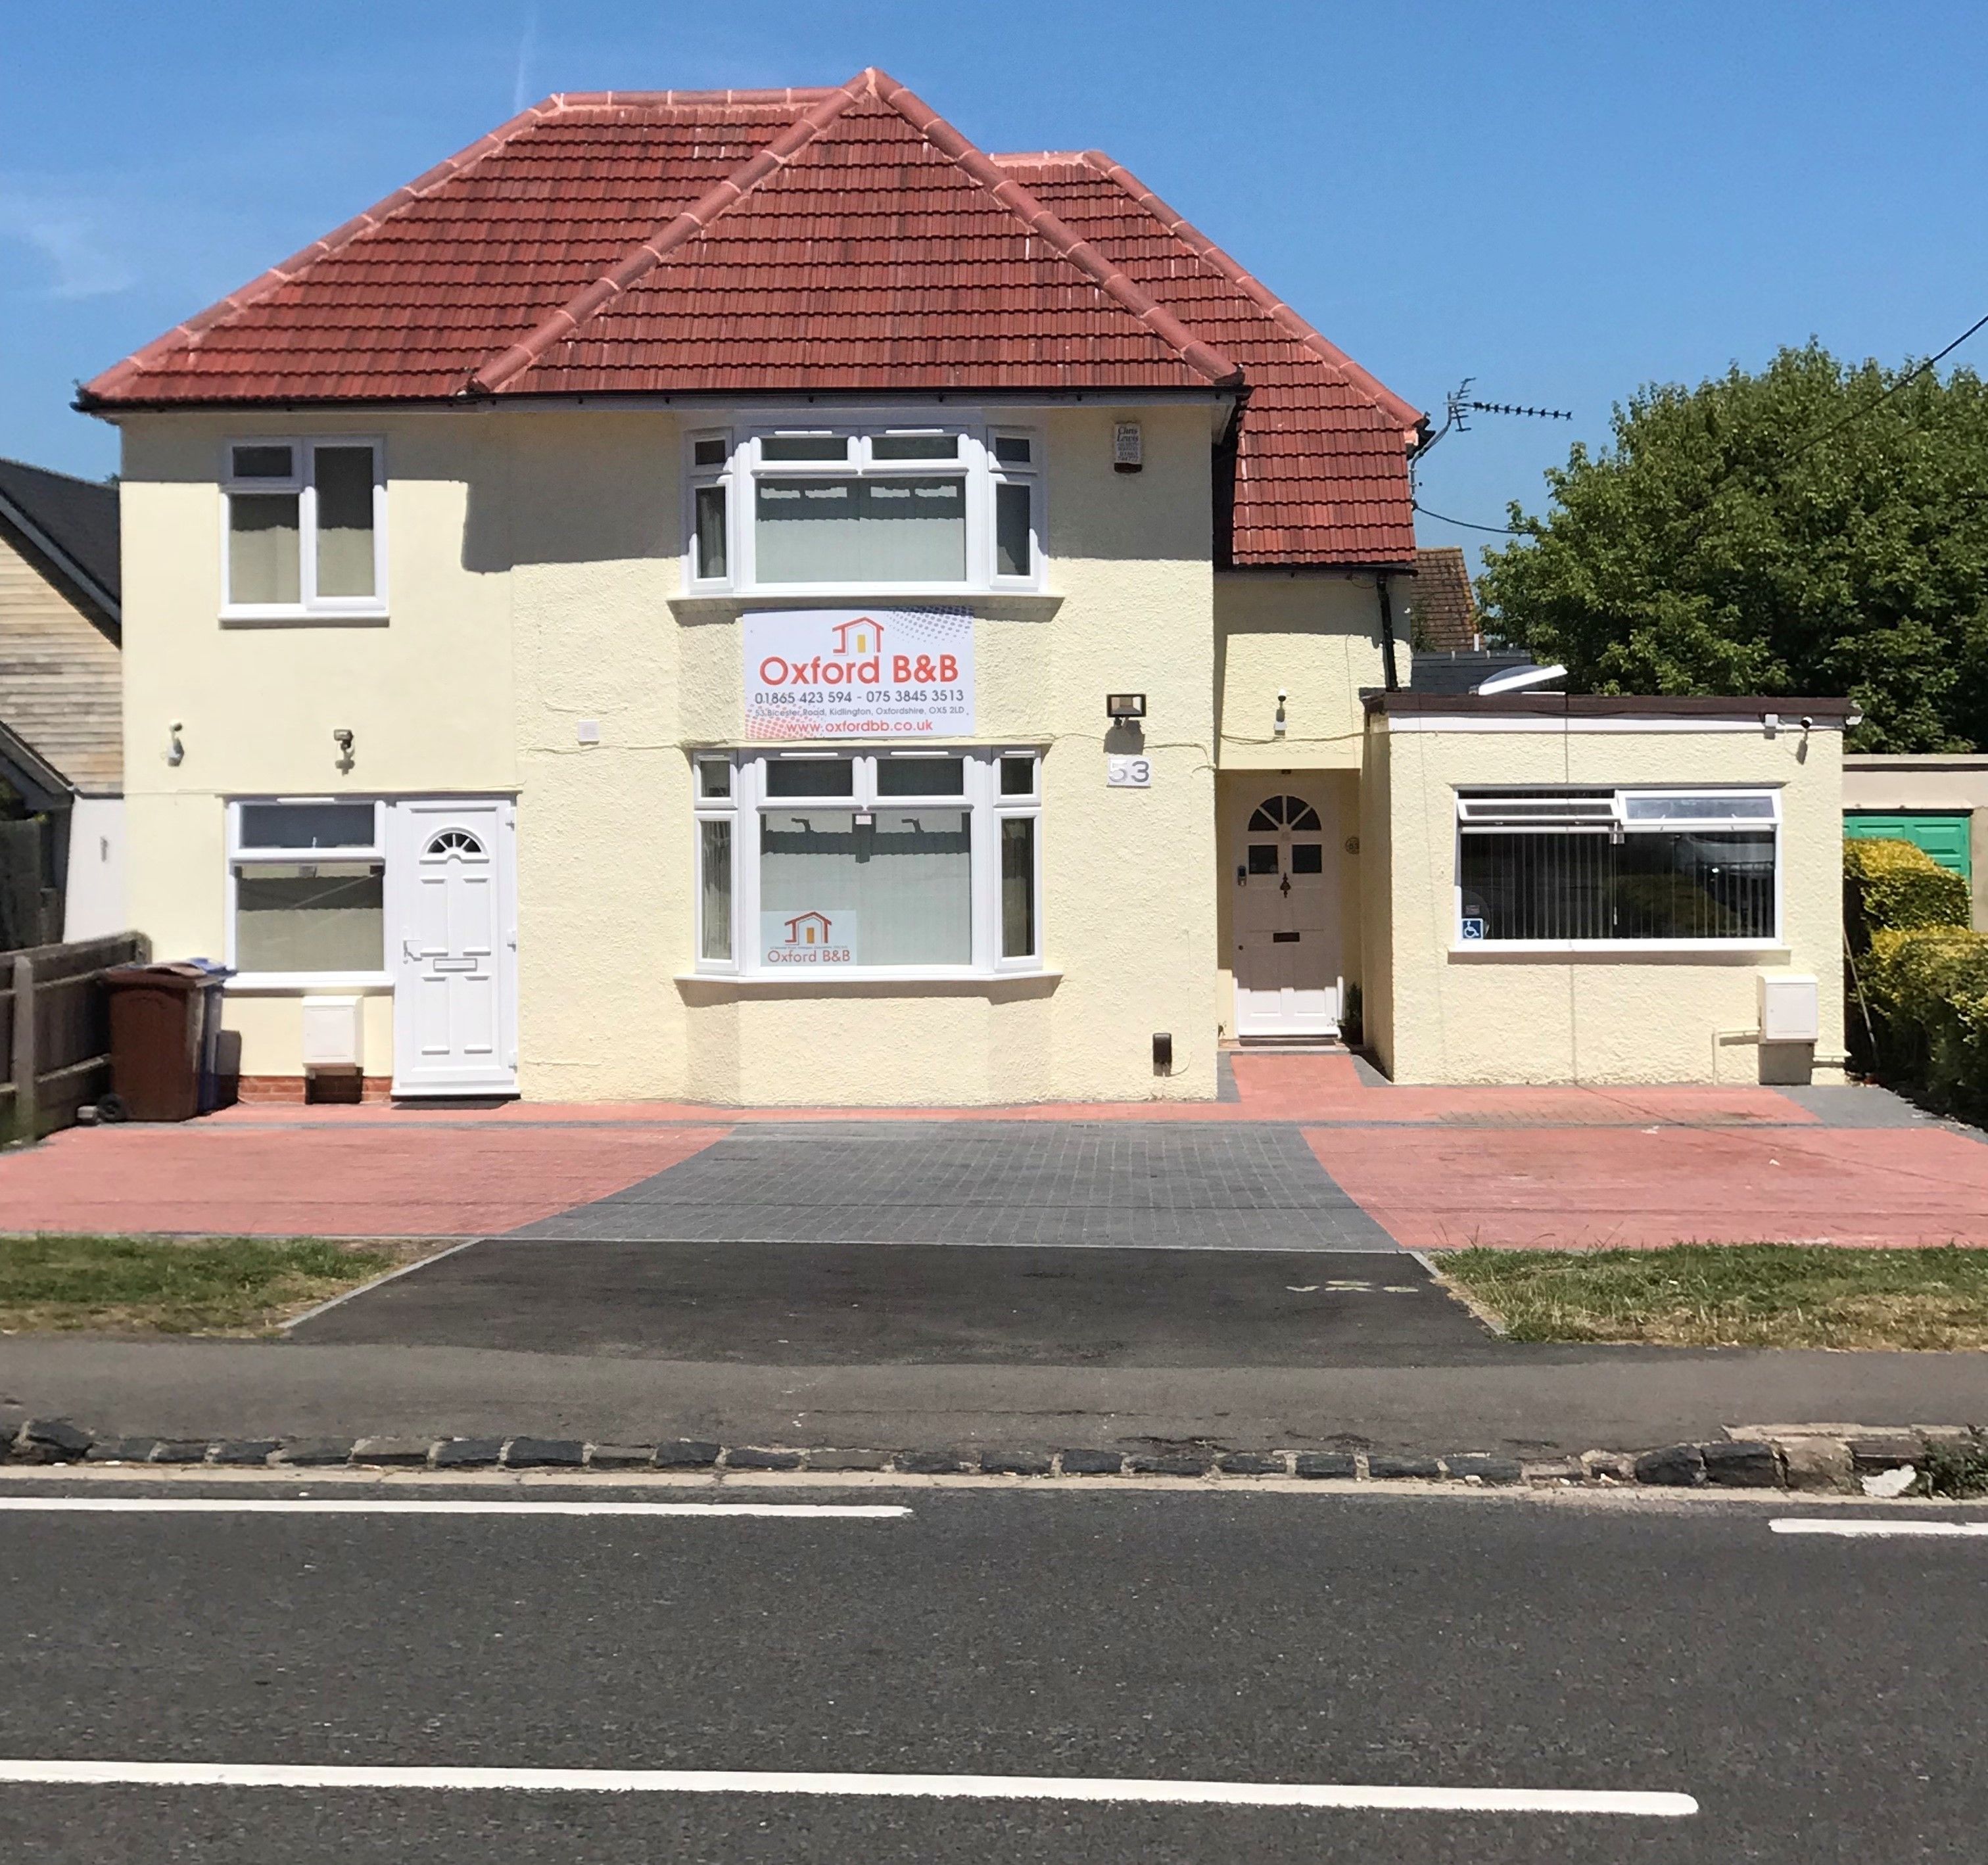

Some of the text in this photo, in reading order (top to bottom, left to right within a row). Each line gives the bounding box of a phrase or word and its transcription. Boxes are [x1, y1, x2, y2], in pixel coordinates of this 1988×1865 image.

[759, 654, 958, 685] Oxford B&B
[755, 692, 795, 705] 01865
[799, 692, 824, 704] 423
[828, 691, 853, 703] 594
[866, 690, 891, 703] 075
[895, 690, 928, 702] 3845
[931, 690, 964, 701] 3513
[829, 707, 873, 717] Kidlington,
[787, 720, 933, 732] www.oxfordbb.co.uk
[1108, 760, 1149, 782] 53
[768, 949, 851, 963] Oxford B&B
